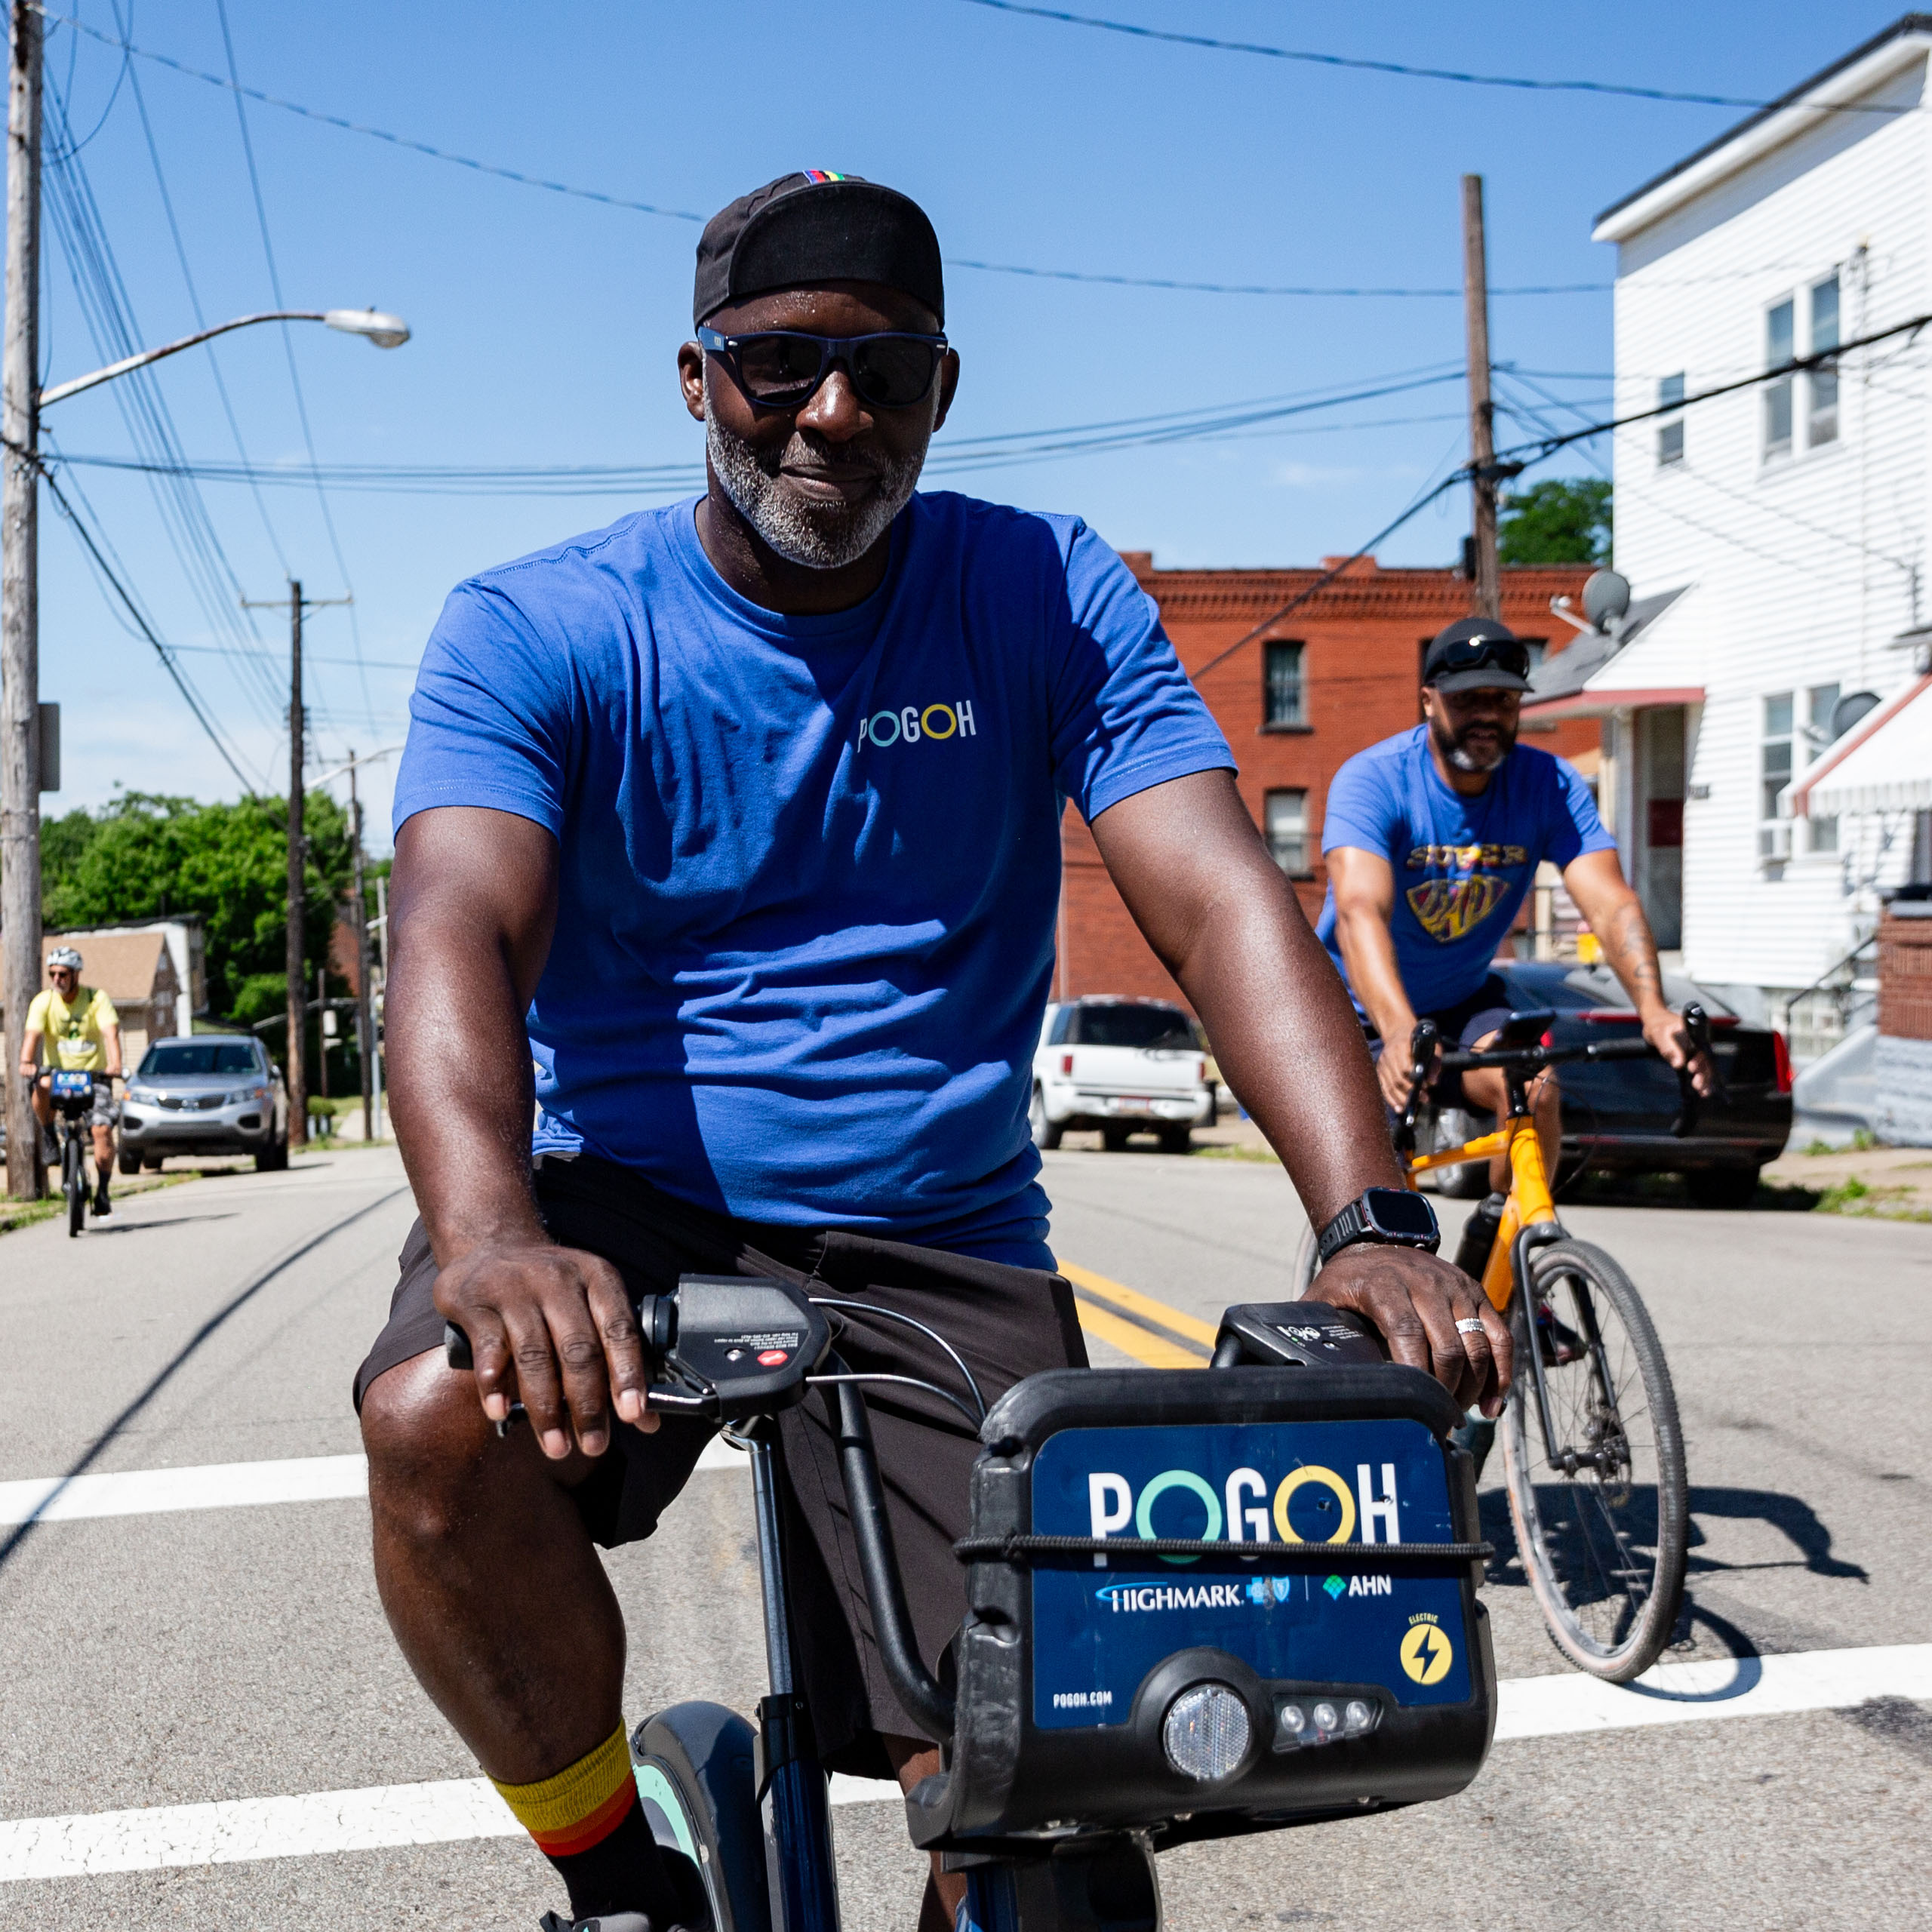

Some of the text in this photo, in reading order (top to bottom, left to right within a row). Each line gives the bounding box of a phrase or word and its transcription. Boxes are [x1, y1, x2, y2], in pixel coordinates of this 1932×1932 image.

[857, 700, 977, 753] POGOH
[1407, 843, 1528, 869] SUPER
[1088, 1463, 1401, 1567] POGOH
[1112, 1575, 1392, 1613] HIGHMARK AHN
[1408, 1612, 1438, 1625] ELECTRIC
[1053, 1690, 1112, 1709] POGOH.COM
